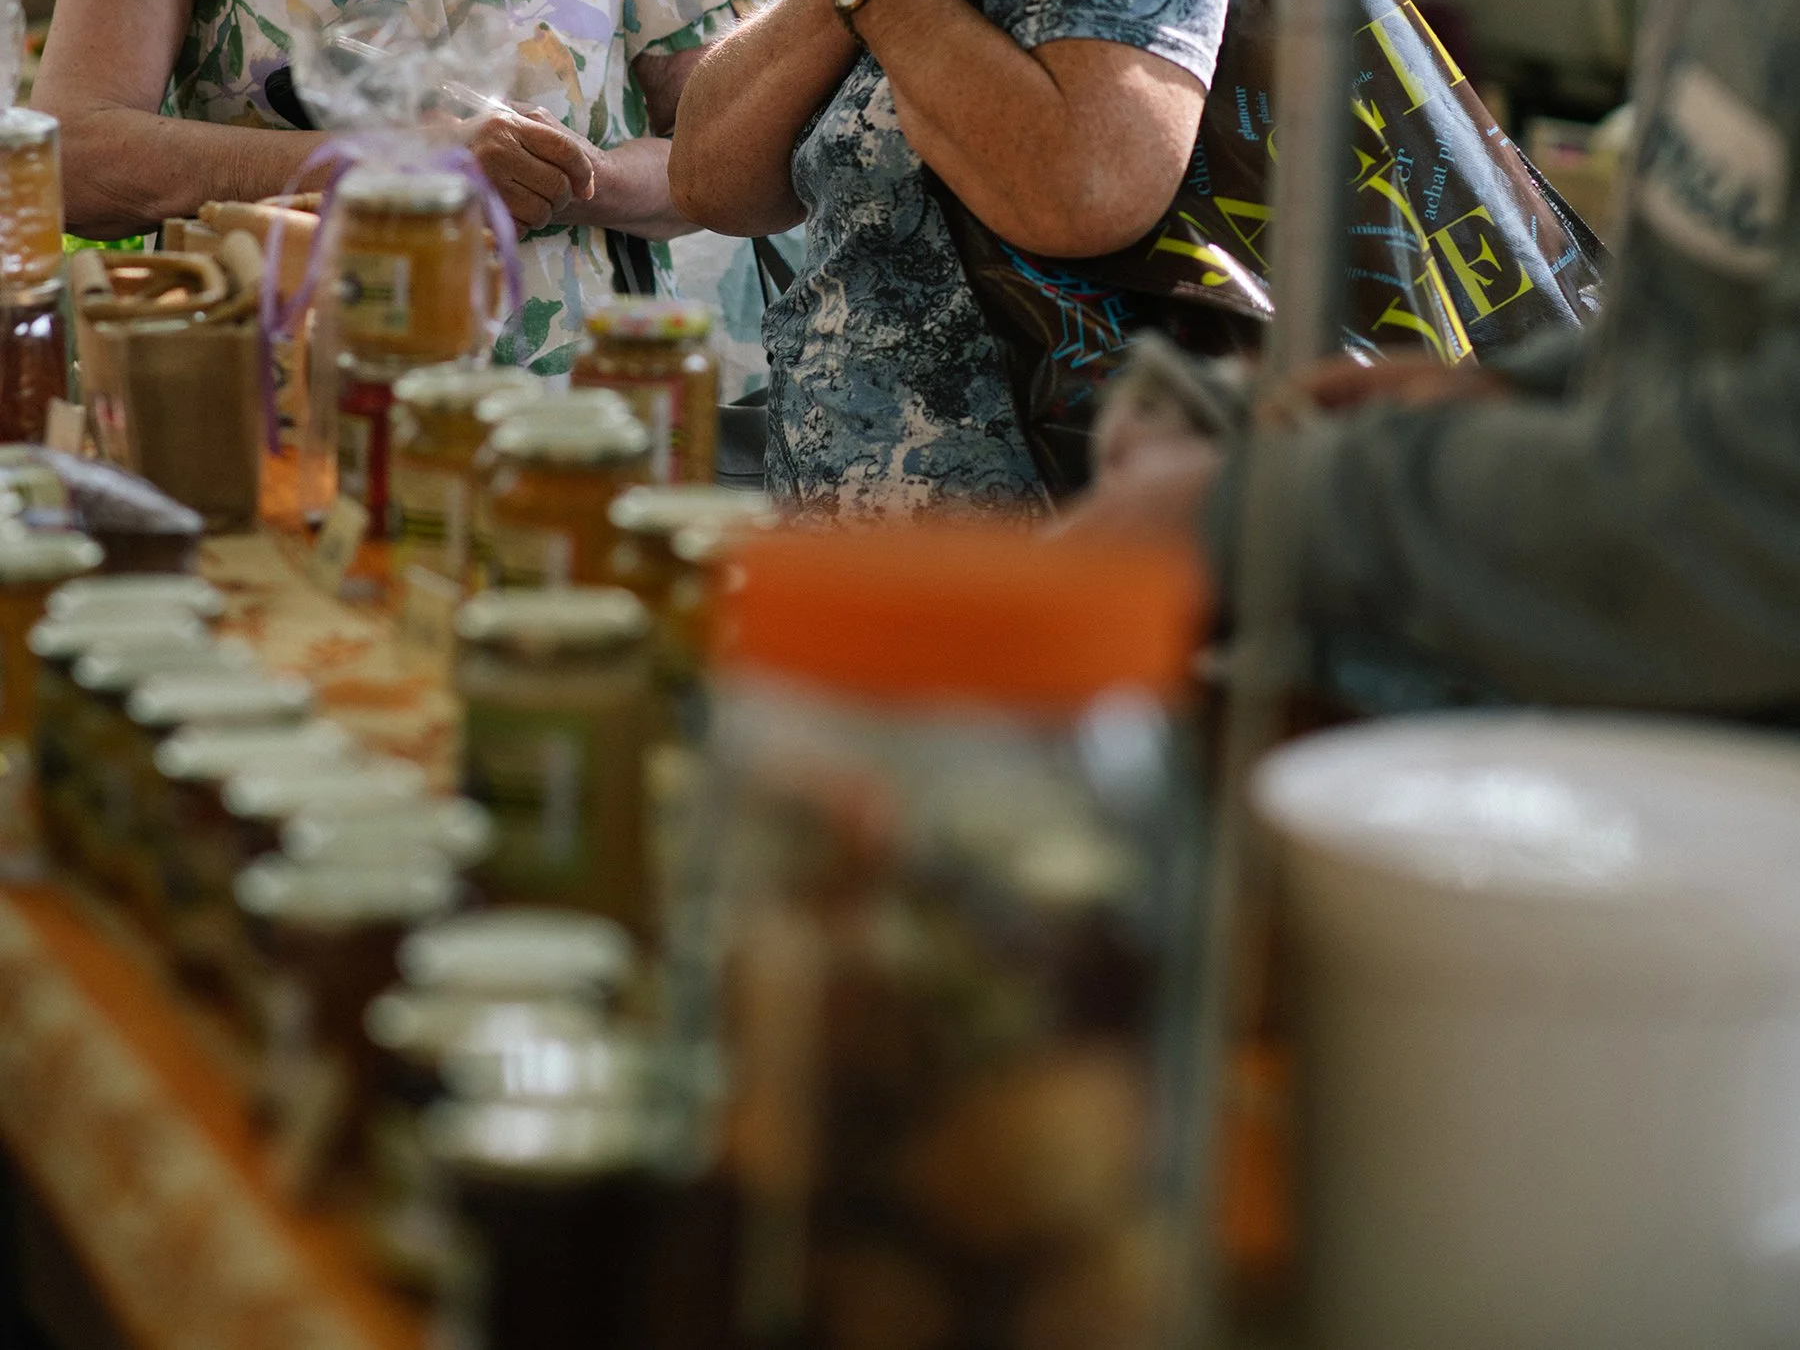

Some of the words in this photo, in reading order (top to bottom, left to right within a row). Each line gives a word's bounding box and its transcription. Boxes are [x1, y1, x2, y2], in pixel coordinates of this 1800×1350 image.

[1235, 84, 1260, 141] glamour
[1255, 90, 1274, 124] plaisir
[1423, 164, 1450, 221] achat
